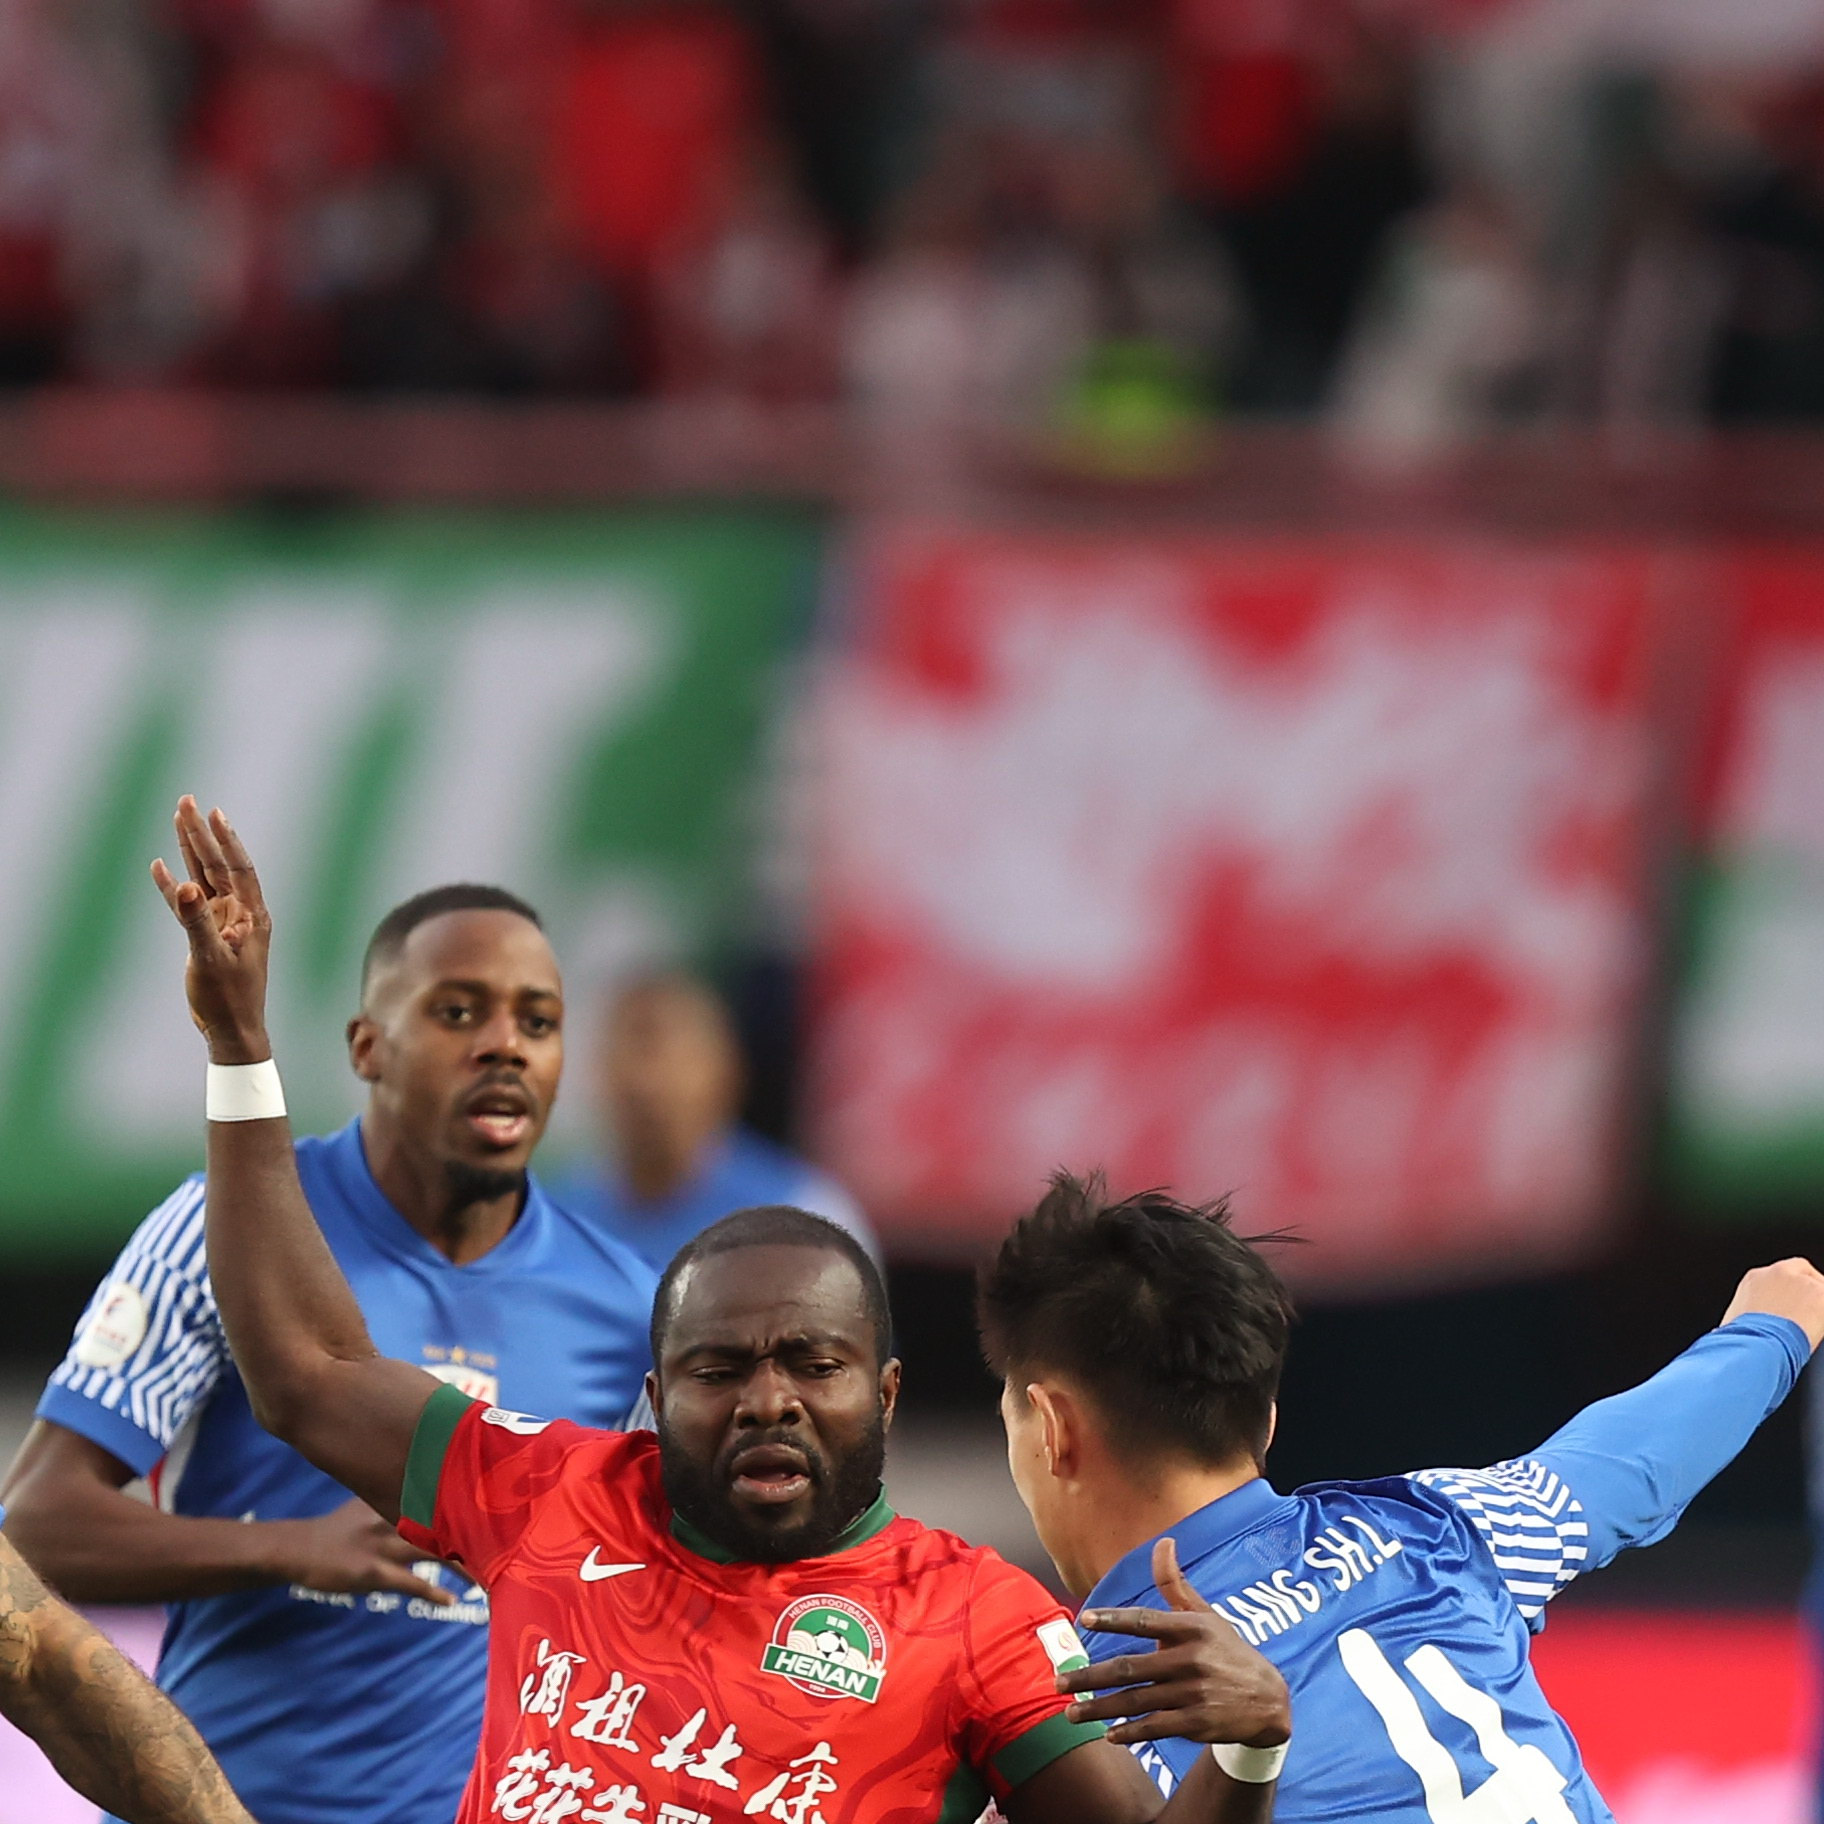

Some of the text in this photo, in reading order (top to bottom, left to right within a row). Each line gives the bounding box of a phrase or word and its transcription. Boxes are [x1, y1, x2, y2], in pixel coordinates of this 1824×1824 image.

[821, 1598, 869, 1626] FOOTBALL
[866, 1623, 882, 1650] CLUB
[1210, 1568, 1321, 1647] IANG
[774, 1650, 869, 1694] HENAN
